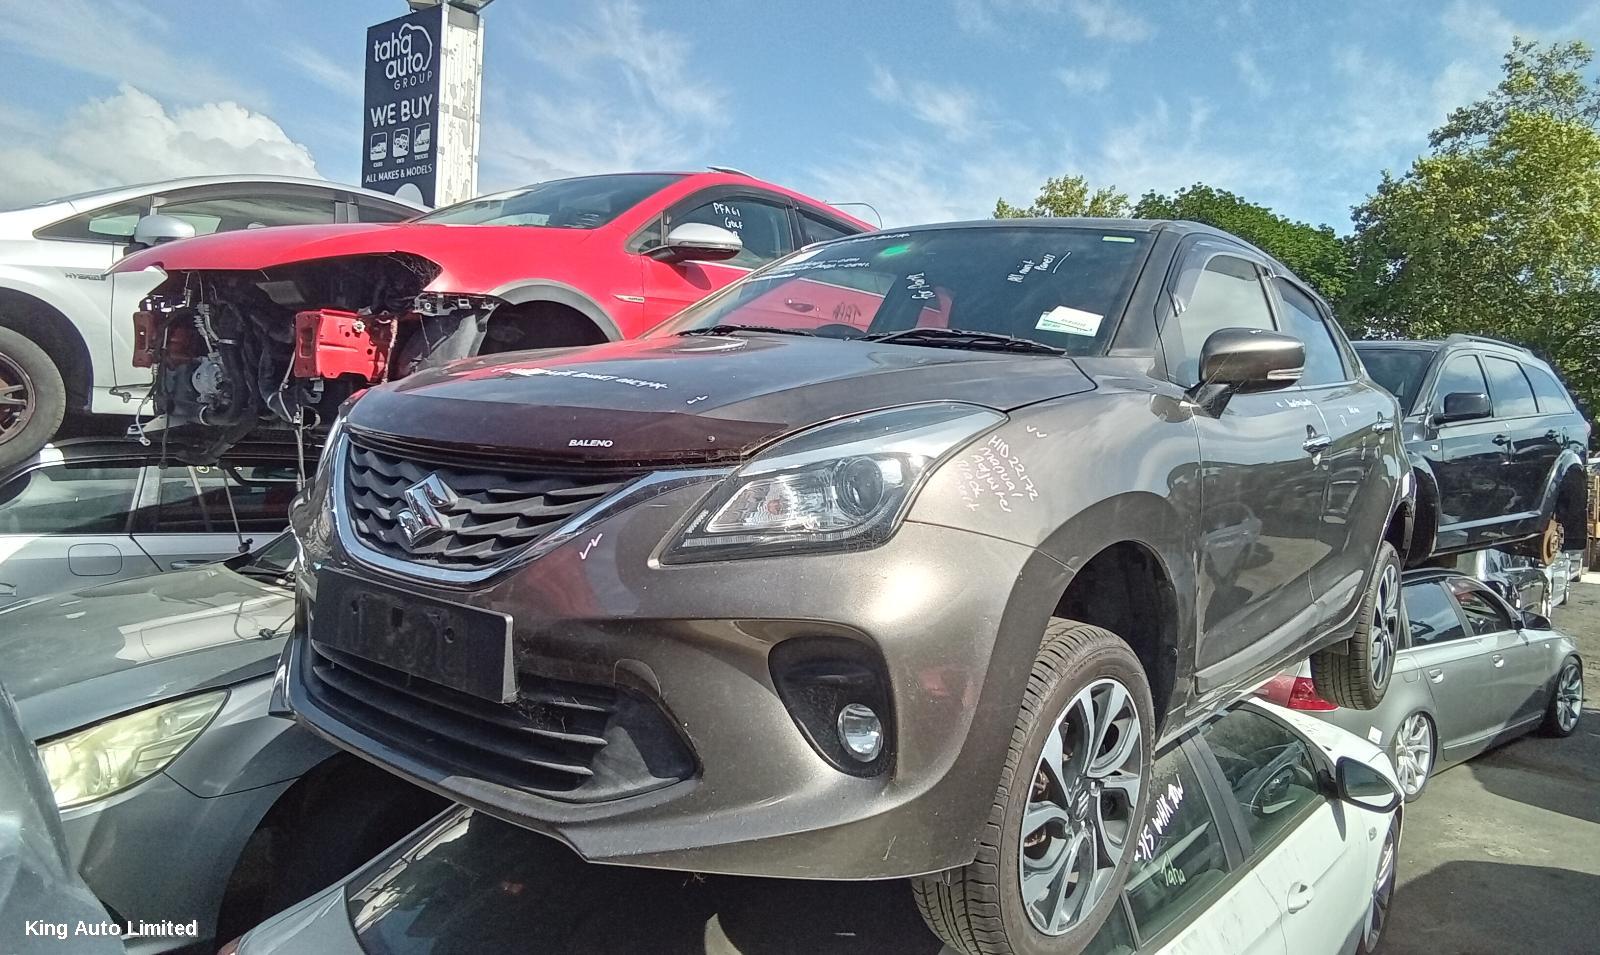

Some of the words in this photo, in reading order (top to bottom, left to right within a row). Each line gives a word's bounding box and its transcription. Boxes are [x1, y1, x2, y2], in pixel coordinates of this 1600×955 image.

[374, 32, 412, 62] taha
[386, 53, 423, 79] auto
[394, 70, 432, 90] GROUP
[371, 103, 396, 127] WE
[401, 94, 432, 121] BUY
[366, 173, 378, 183] ALL
[379, 169, 399, 181] MAKES
[400, 168, 405, 178] &
[406, 163, 432, 177] MODELS
[568, 439, 614, 448] BALENO
